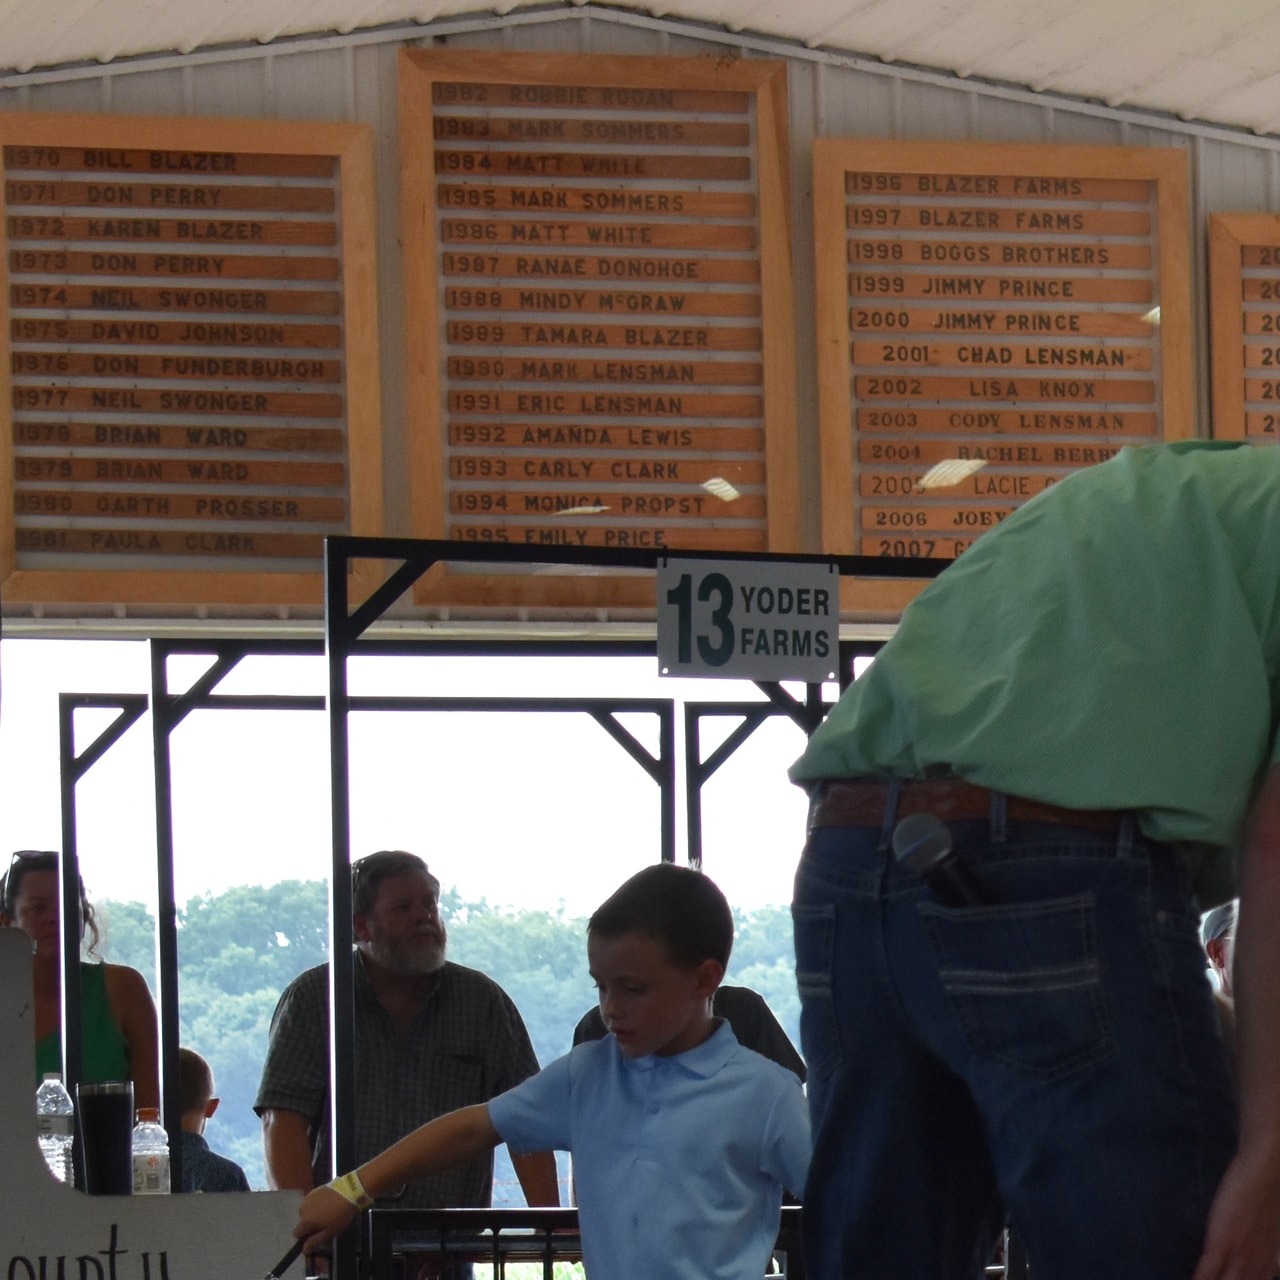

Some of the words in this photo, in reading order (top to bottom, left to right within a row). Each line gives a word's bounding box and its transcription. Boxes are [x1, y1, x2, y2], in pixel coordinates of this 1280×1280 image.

[437, 118, 491, 137] 1983
[508, 120, 565, 138] MARK
[582, 121, 685, 140] SOMMERS
[84, 151, 132, 168] BILL
[150, 153, 237, 171] BLAZER
[440, 152, 492, 170] 1984
[507, 155, 563, 173] MATT
[582, 157, 646, 174] WHITE
[851, 174, 901, 192] 1996
[918, 175, 999, 194] BLAZER
[1014, 178, 1082, 195] FARMS
[446, 188, 497, 207] 1985
[511, 190, 568, 208] MARK
[582, 192, 685, 211] SOMMERS
[11, 218, 65, 235] 1972
[88, 220, 161, 238] KAREN
[177, 222, 263, 240] BLAZER
[853, 209, 901, 226] 1997
[920, 210, 999, 227] BLAZER
[1017, 212, 1083, 230] FARMS
[448, 222, 497, 240] 1986
[511, 224, 570, 242] MATT
[588, 226, 651, 243] WHITE
[12, 253, 67, 270] 1973
[92, 255, 137, 271] DON
[154, 257, 225, 273] PERRY
[855, 244, 904, 260] 1998
[920, 244, 990, 261] BOGGS
[1002, 246, 1109, 265] BROTHERS
[450, 256, 499, 273] 1987
[516, 258, 586, 275] RANAE
[599, 260, 698, 278] DONOHOE
[855, 276, 904, 293] 1999
[921, 278, 985, 295] JIMMY
[1000, 280, 1073, 297] PRINCE
[14, 288, 68, 305] 1974
[92, 290, 140, 308] NEIL
[159, 291, 267, 310] SWONGER
[451, 290, 503, 307] 1988
[520, 292, 586, 310] MINDY
[856, 311, 909, 328] 2000
[933, 312, 995, 330] JIMMY
[1006, 314, 1080, 331] PRINCE
[15, 322, 69, 339] 1975
[92, 323, 160, 341] DAVID
[183, 325, 284, 343] JOHNSON
[453, 324, 504, 342] 1989
[522, 326, 608, 345] TAMARA
[625, 328, 708, 346] BLAZER
[882, 345, 929, 362] 2001
[957, 346, 1012, 365] CHAD
[1025, 348, 1125, 366] LENSMAN
[16, 356, 69, 372] 1976
[94, 357, 139, 374] DON
[162, 358, 325, 378] FUNDERBURGH
[453, 359, 504, 377] 1990
[522, 362, 578, 379] MARK
[593, 363, 694, 381] LENSMAN
[867, 379, 922, 395] 2002
[969, 381, 1018, 398] LISA
[1040, 382, 1095, 399] KNOX
[16, 390, 69, 406] 1977
[92, 391, 142, 409] NEIL
[160, 393, 268, 412] SWONGER
[455, 393, 501, 410] 1991
[518, 396, 565, 412] ERIC
[581, 396, 683, 414] LENSMAN
[867, 412, 918, 428] 2003
[949, 413, 1000, 429] CODY
[1019, 414, 1124, 430] LENSMAN
[17, 425, 70, 442] 1978
[95, 426, 161, 444] BRIAN
[186, 428, 248, 446] WARD
[456, 425, 506, 443] 1992
[522, 428, 612, 446] AMANDA
[628, 429, 693, 446] LEWIS
[871, 444, 921, 460] 2004
[957, 445, 1043, 463] RACHEL
[18, 462, 73, 478] 1979
[96, 462, 163, 480] BRIAN
[187, 463, 249, 481] WARD
[456, 458, 507, 476] 1993
[524, 460, 593, 478] CARLY
[611, 461, 679, 480] CLARK
[974, 477, 1030, 495] LACIE
[456, 493, 508, 511] 1994
[524, 495, 604, 511] MONICA
[621, 497, 705, 515] PROPST
[876, 511, 927, 527] 2006
[953, 511, 1006, 527] JOEY
[456, 528, 509, 543] 1995
[525, 529, 588, 546] EMILY
[605, 530, 666, 547] PRICE
[880, 541, 935, 558] 2007
[740, 586, 830, 616] YODER
[667, 572, 735, 667] 13
[741, 628, 830, 658] FARMS
